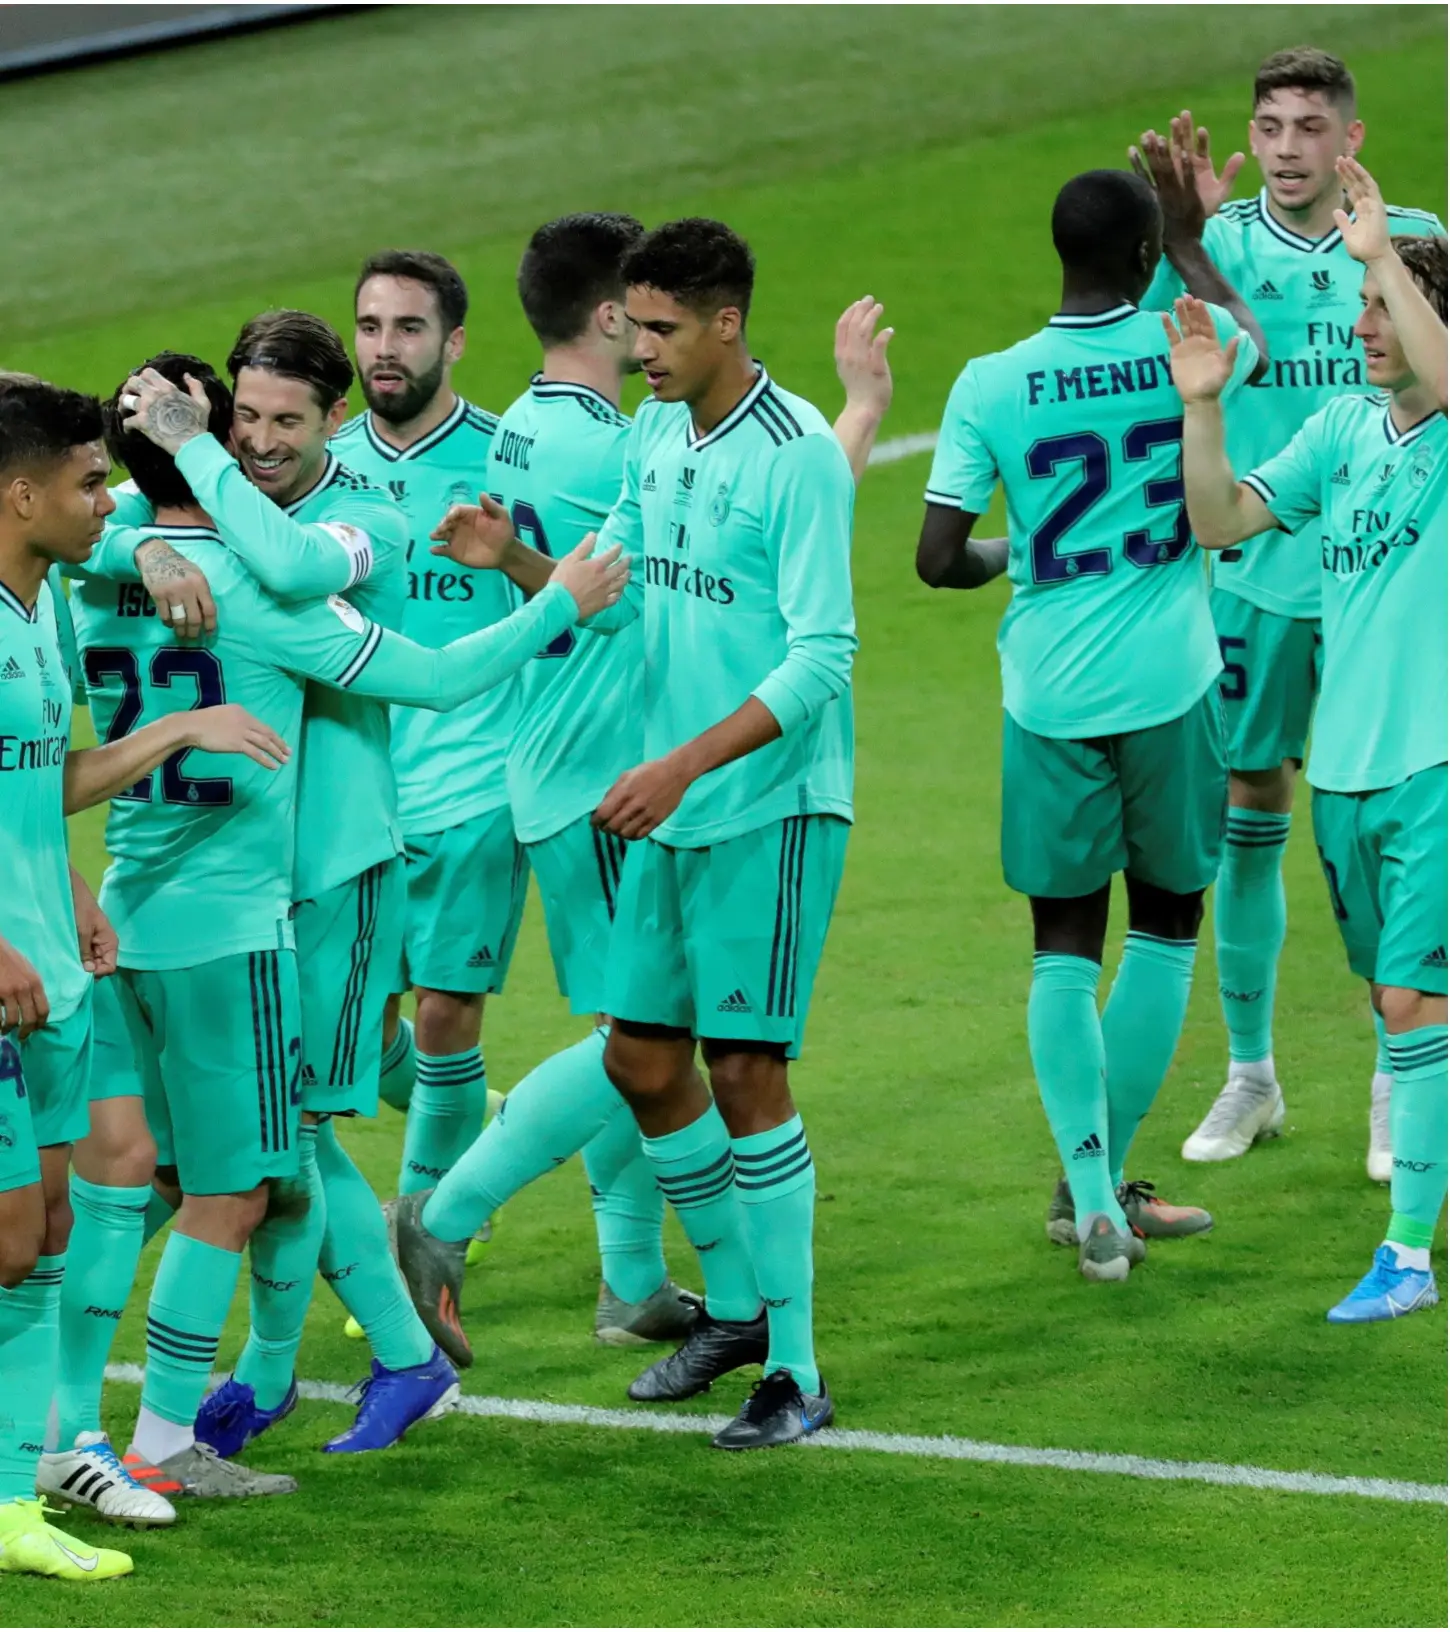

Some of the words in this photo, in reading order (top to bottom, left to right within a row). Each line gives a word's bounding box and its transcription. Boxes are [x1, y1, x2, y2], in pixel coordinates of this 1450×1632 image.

[1307, 321, 1355, 350] Fly
[1025, 414, 1192, 584] 23
[117, 583, 157, 617] ISC
[407, 569, 475, 602] ates
[83, 646, 233, 806] 22
[408, 1160, 449, 1180] RMC
[1072, 1149, 1105, 1160] adidas
[84, 1304, 123, 1320] RMC
